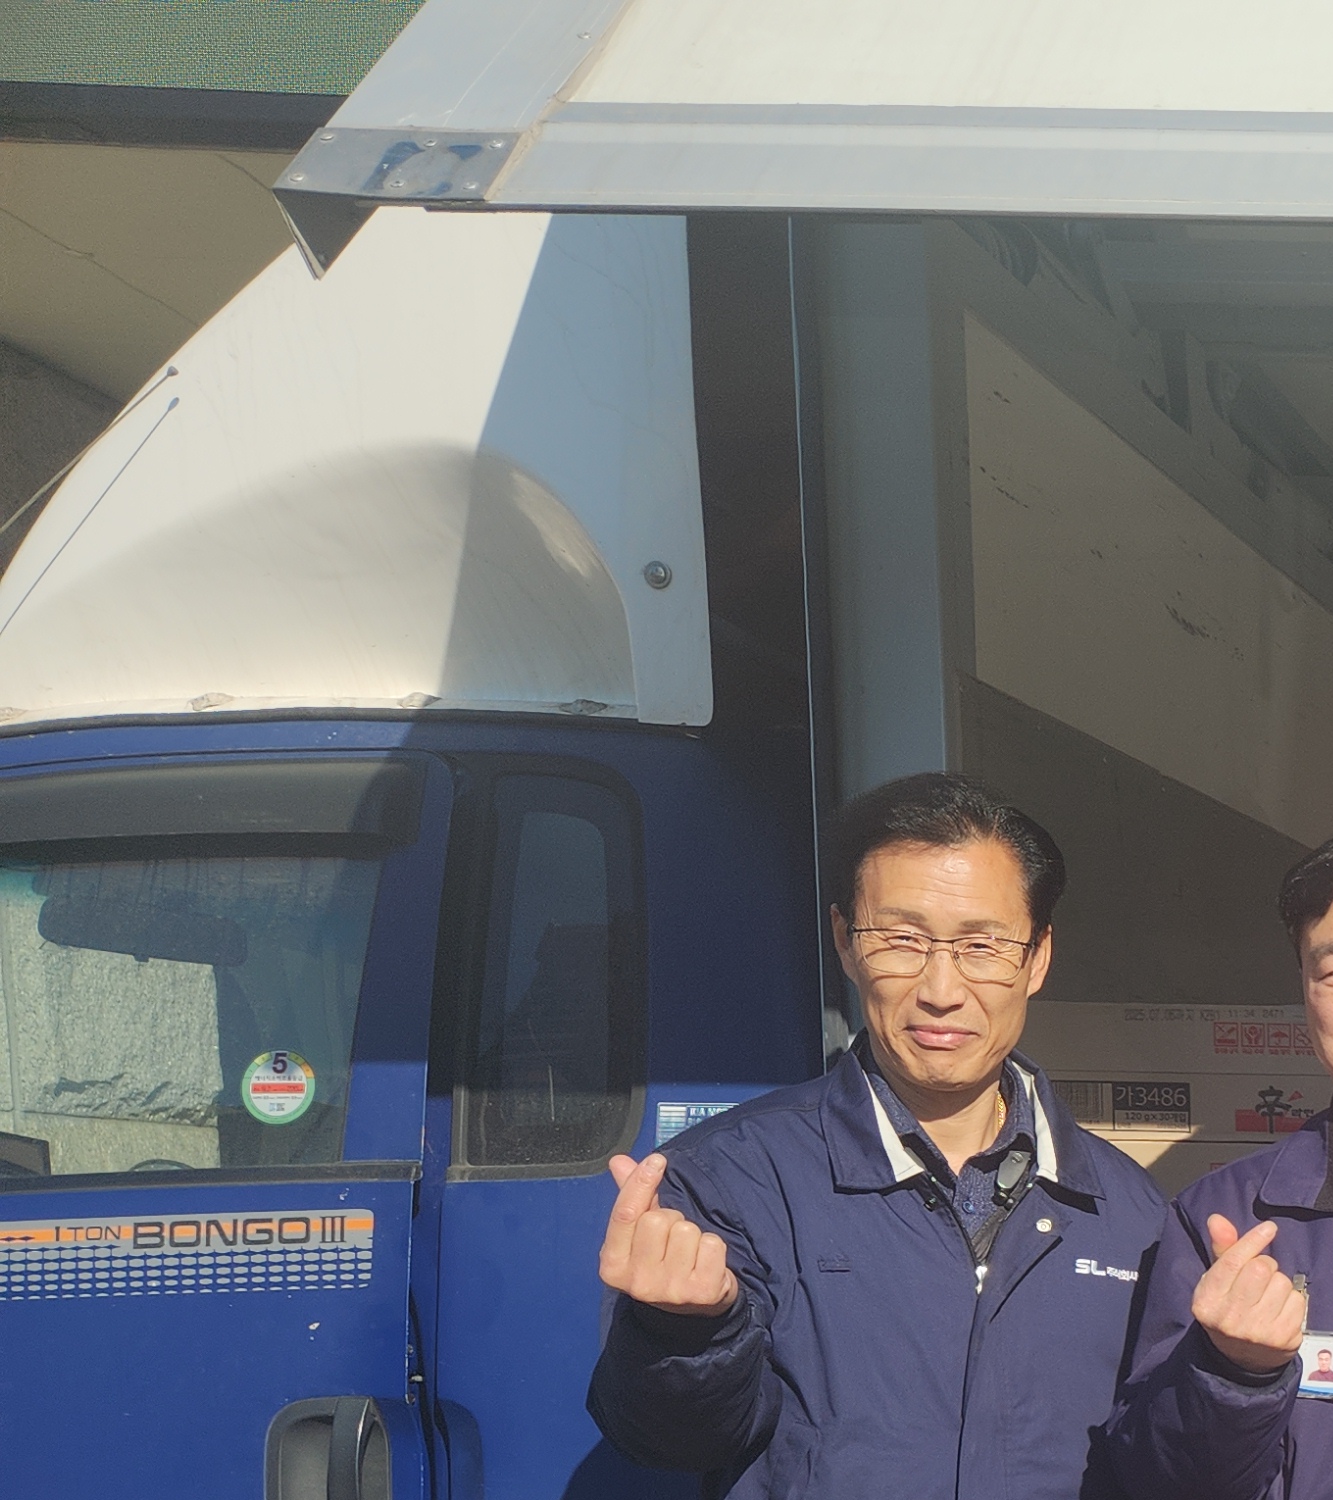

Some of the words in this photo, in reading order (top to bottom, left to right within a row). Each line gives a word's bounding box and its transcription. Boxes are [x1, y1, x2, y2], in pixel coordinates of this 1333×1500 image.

[272, 1052, 288, 1074] 5
[1116, 1086, 1187, 1108] 가3486
[67, 1225, 122, 1242] TON
[132, 1216, 311, 1250] BONGO
[1075, 1258, 1107, 1276] SL
